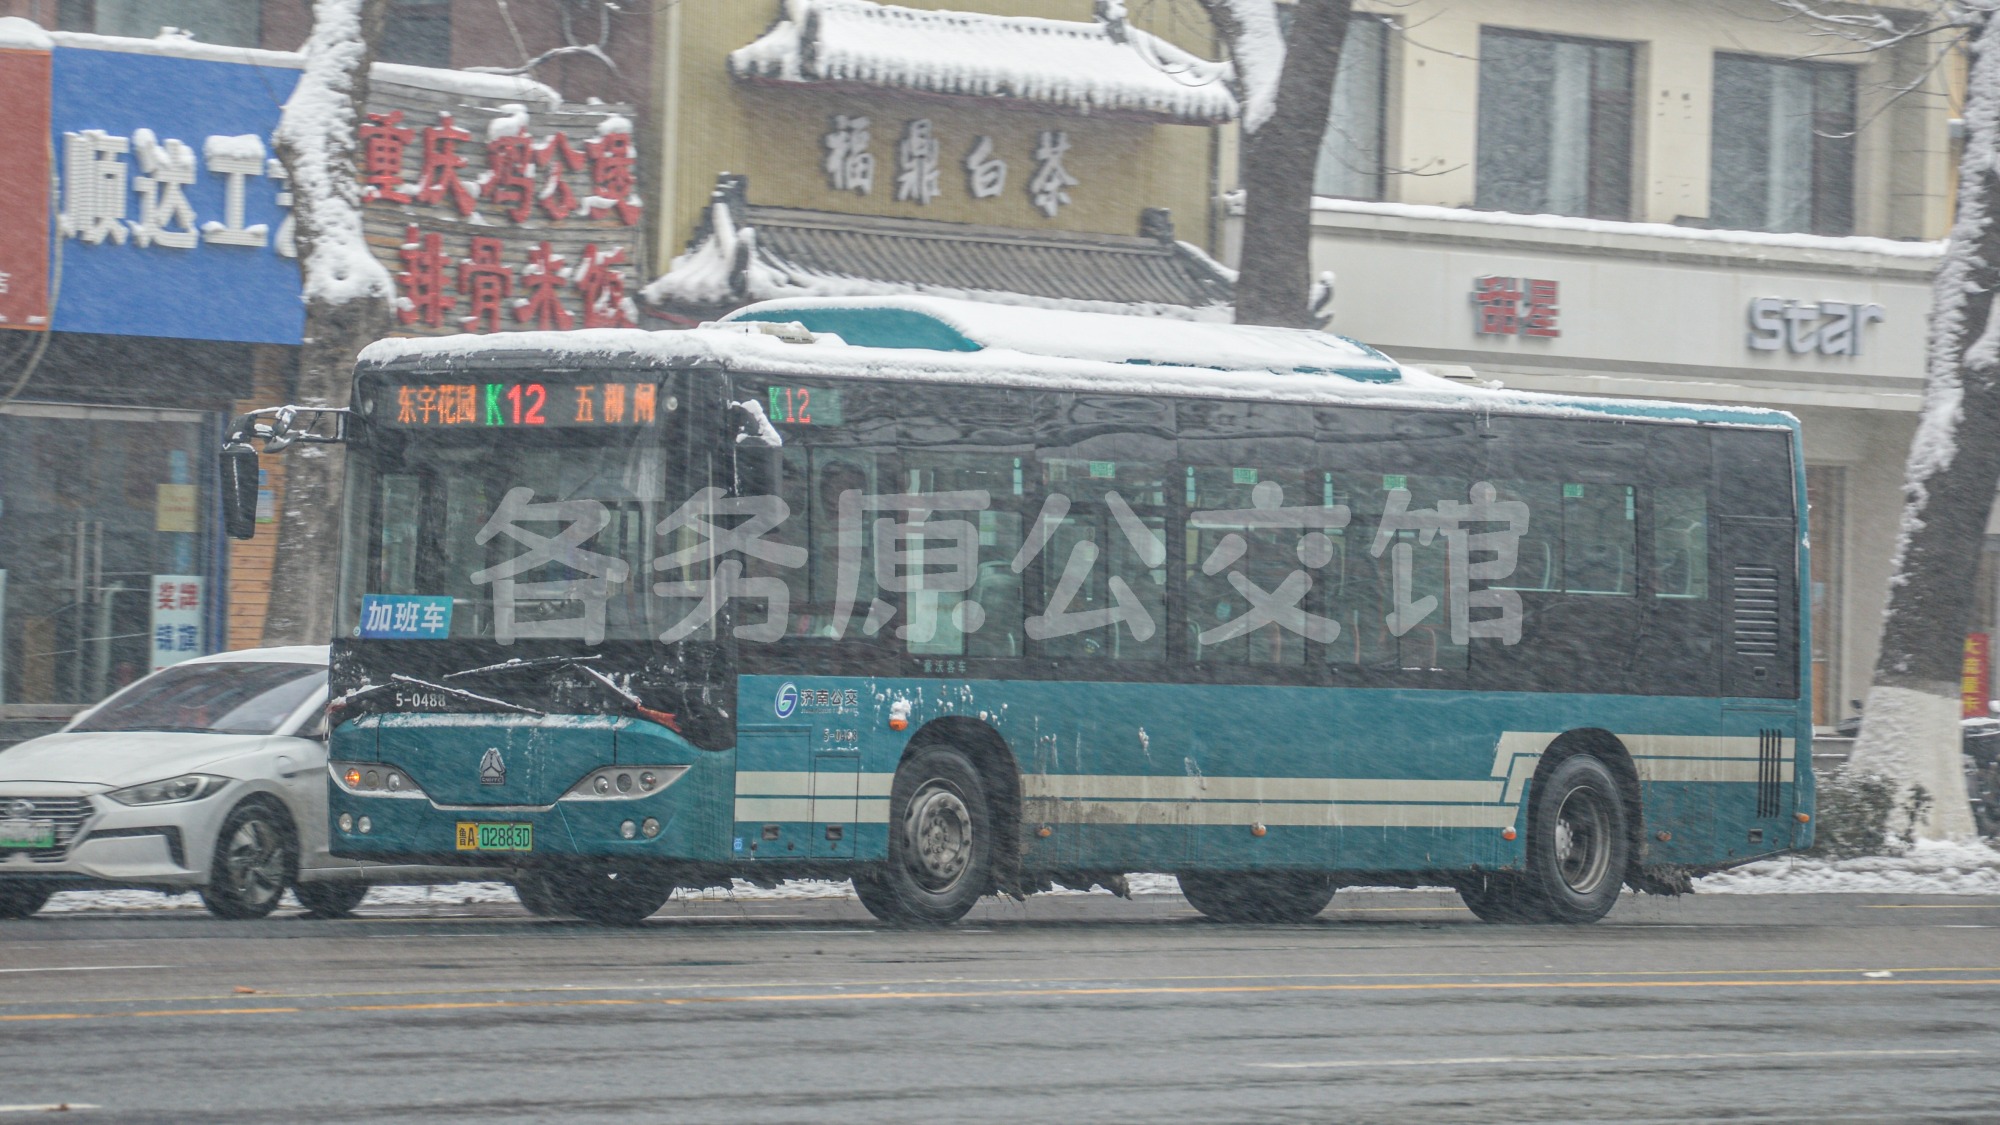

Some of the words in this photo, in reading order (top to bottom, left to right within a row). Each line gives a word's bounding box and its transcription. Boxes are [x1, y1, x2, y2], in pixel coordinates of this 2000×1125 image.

[359, 103, 643, 225] 重庆鸡公煲
[824, 114, 1080, 217] 福鼎白茶
[397, 222, 638, 332] 排骨米饭
[1748, 296, 1886, 356] star
[397, 384, 477, 425] 东宇花园
[485, 383, 546, 426] K12
[768, 386, 811, 423] K12
[366, 601, 446, 633] 加班车
[923, 659, 967, 674] 豪沃客车
[396, 693, 446, 707] 5-0488
[801, 689, 858, 706] 济南公交
